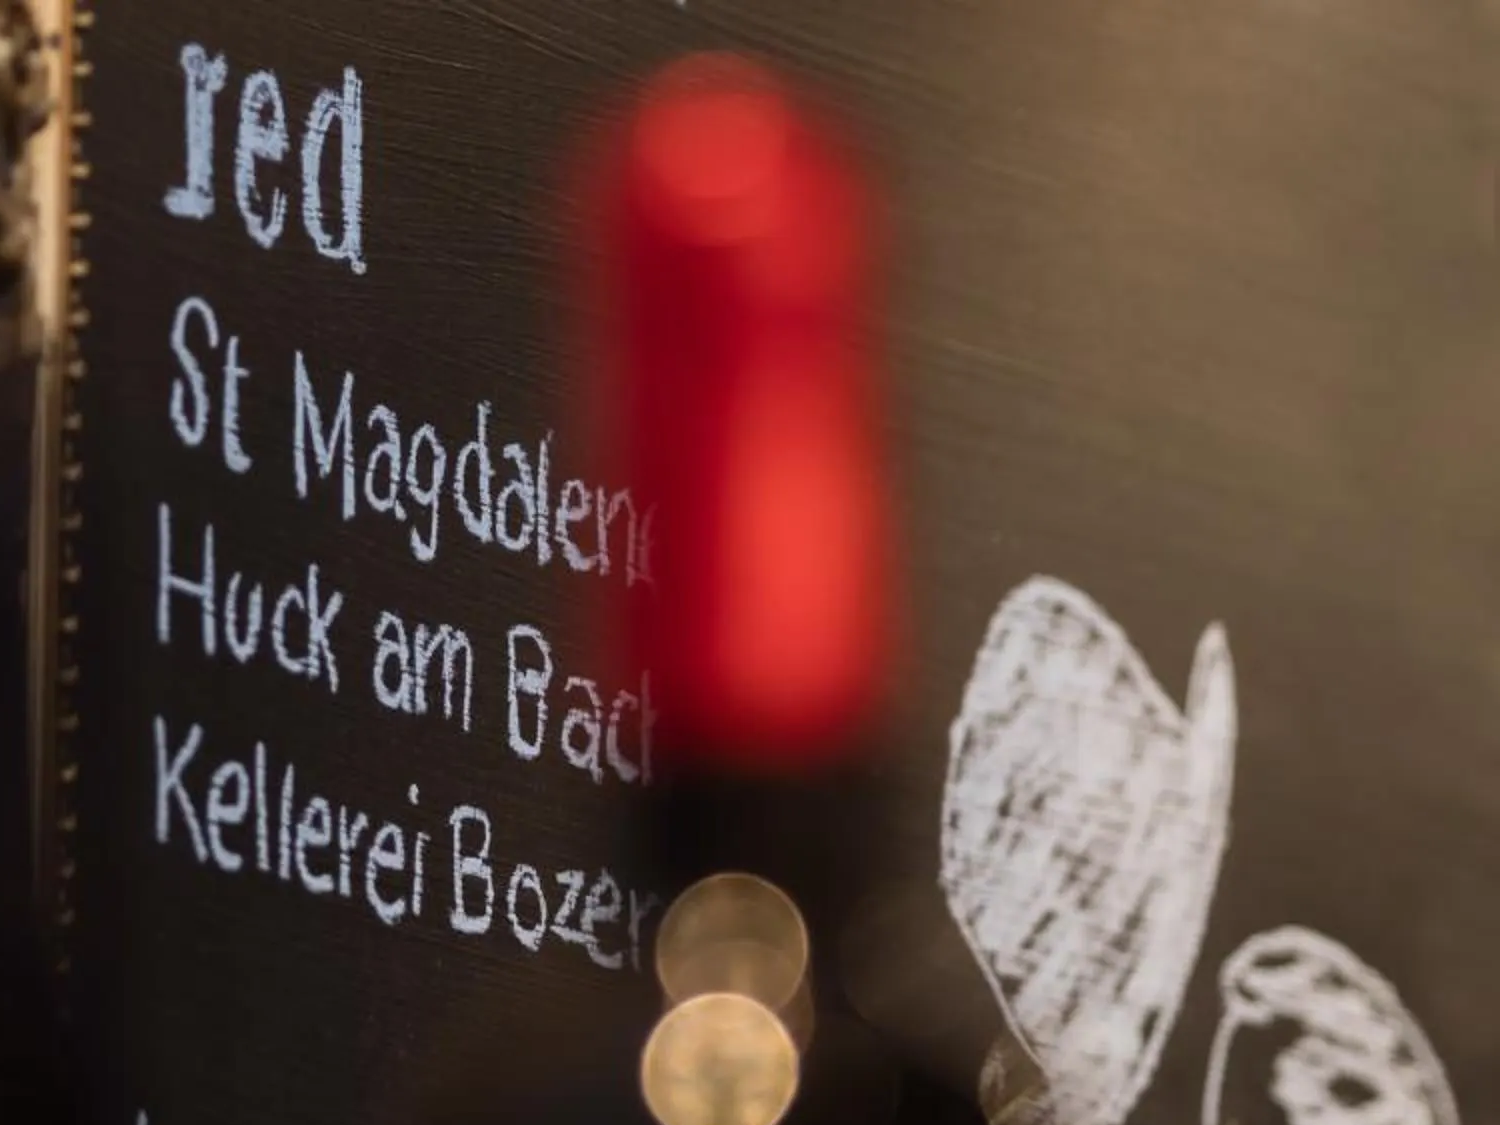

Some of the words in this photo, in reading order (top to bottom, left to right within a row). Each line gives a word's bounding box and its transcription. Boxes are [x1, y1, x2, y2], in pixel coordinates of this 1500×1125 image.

[163, 42, 366, 275] red
[170, 297, 252, 474] St
[157, 502, 343, 693] Huck
[372, 610, 473, 732] am
[153, 714, 431, 926] Kellerei
